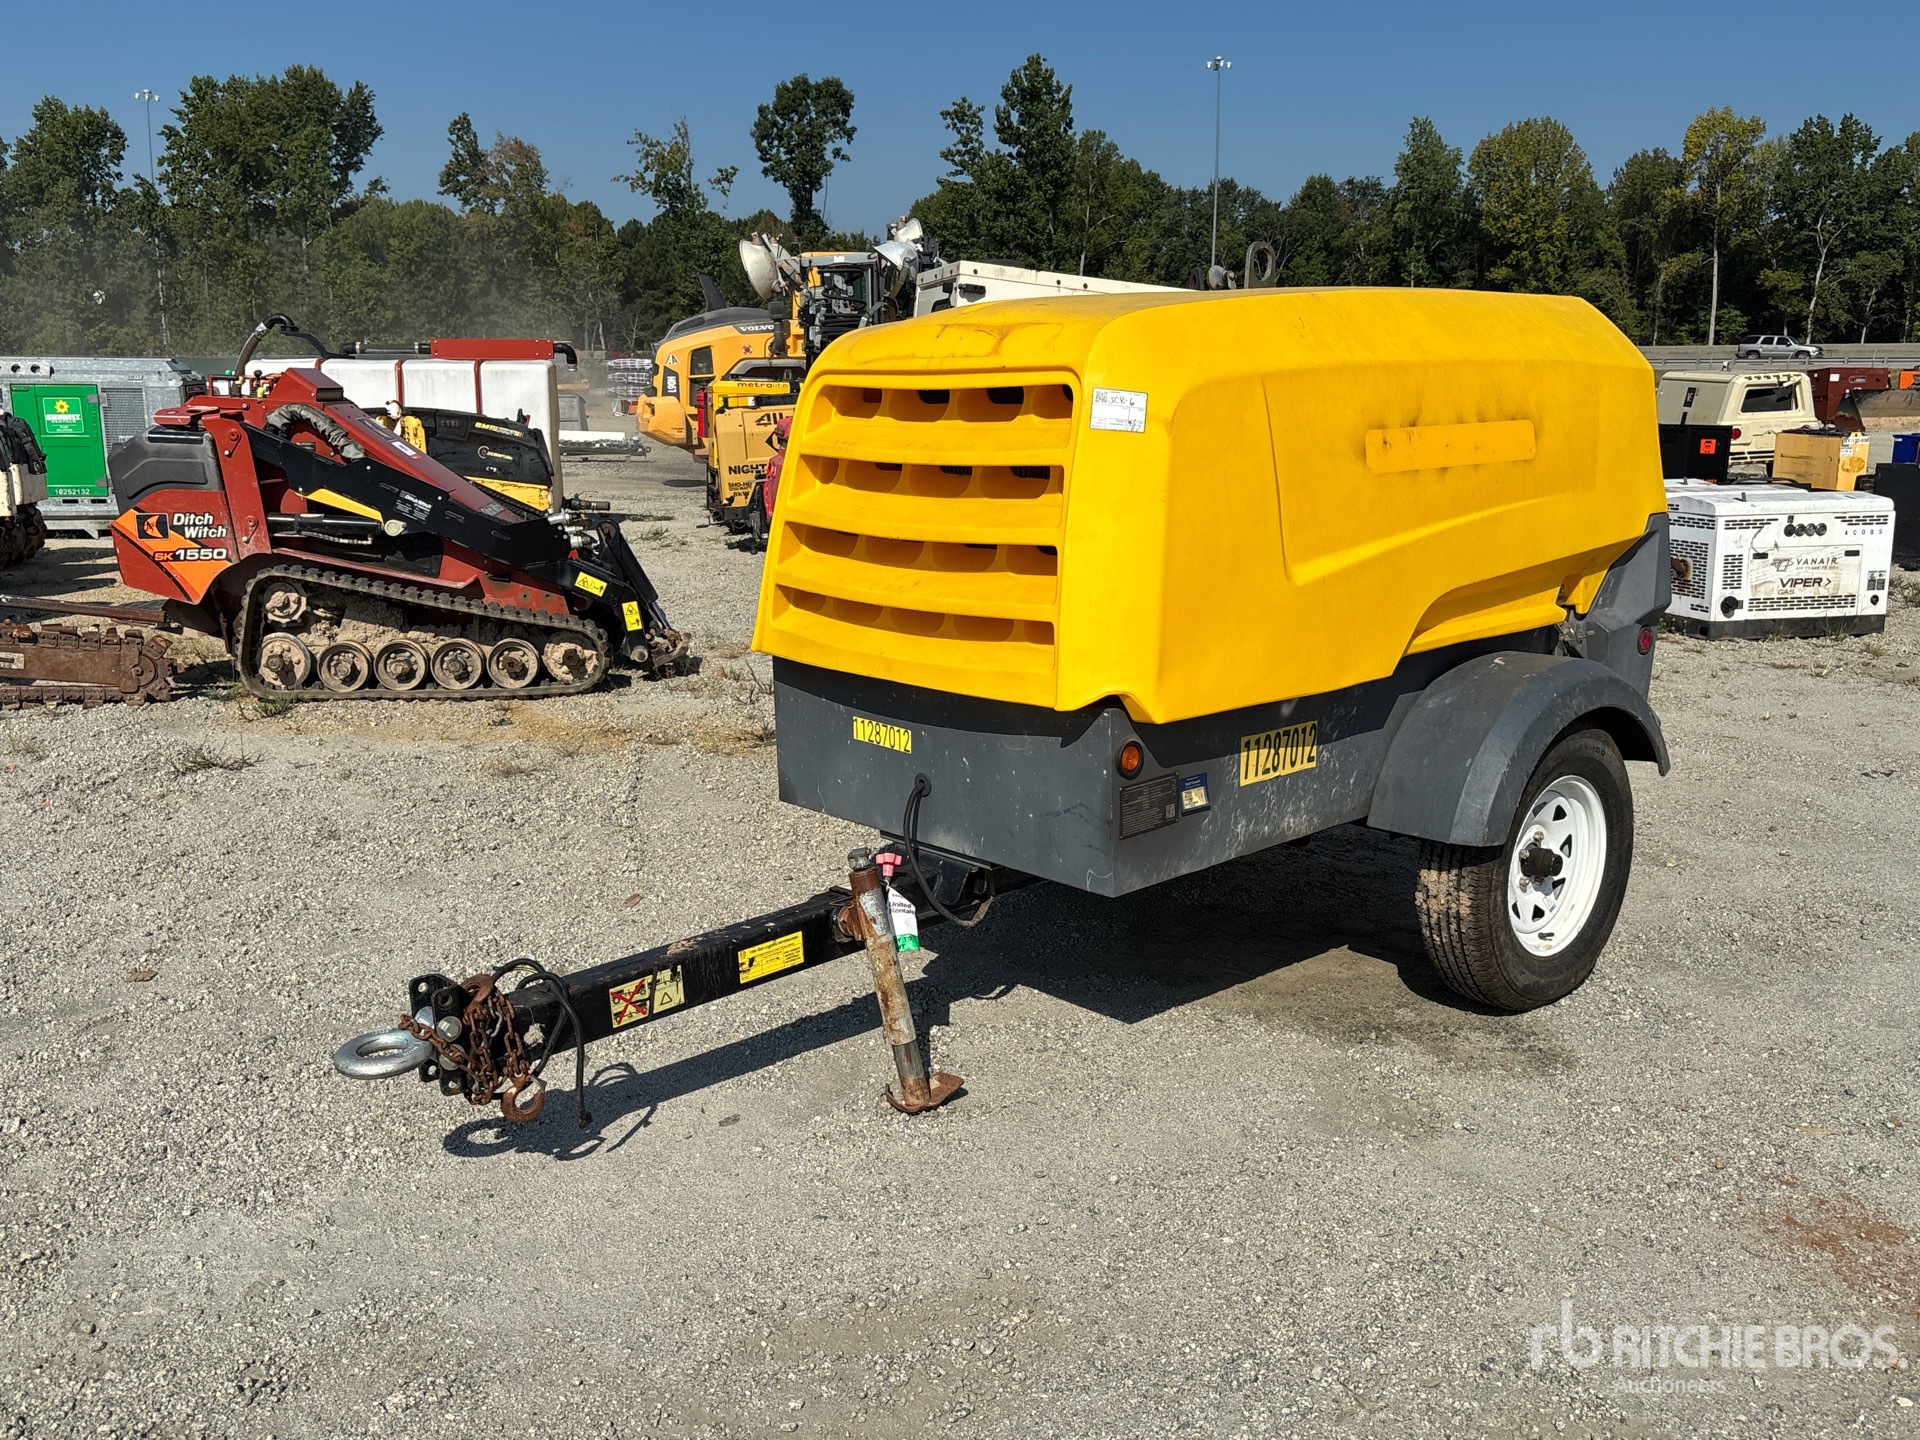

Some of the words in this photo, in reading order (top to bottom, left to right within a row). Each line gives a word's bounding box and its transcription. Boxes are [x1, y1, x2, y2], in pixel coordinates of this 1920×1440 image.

[54, 488, 91, 496] 10252132
[172, 512, 214, 526] Ditch
[184, 525, 227, 539] Witch
[154, 551, 174, 561] SK
[175, 548, 227, 560] 1550
[1779, 577, 1823, 588] VIPER
[853, 718, 911, 753] 11287012
[1244, 723, 1317, 780] 11287012
[889, 901, 912, 909] United
